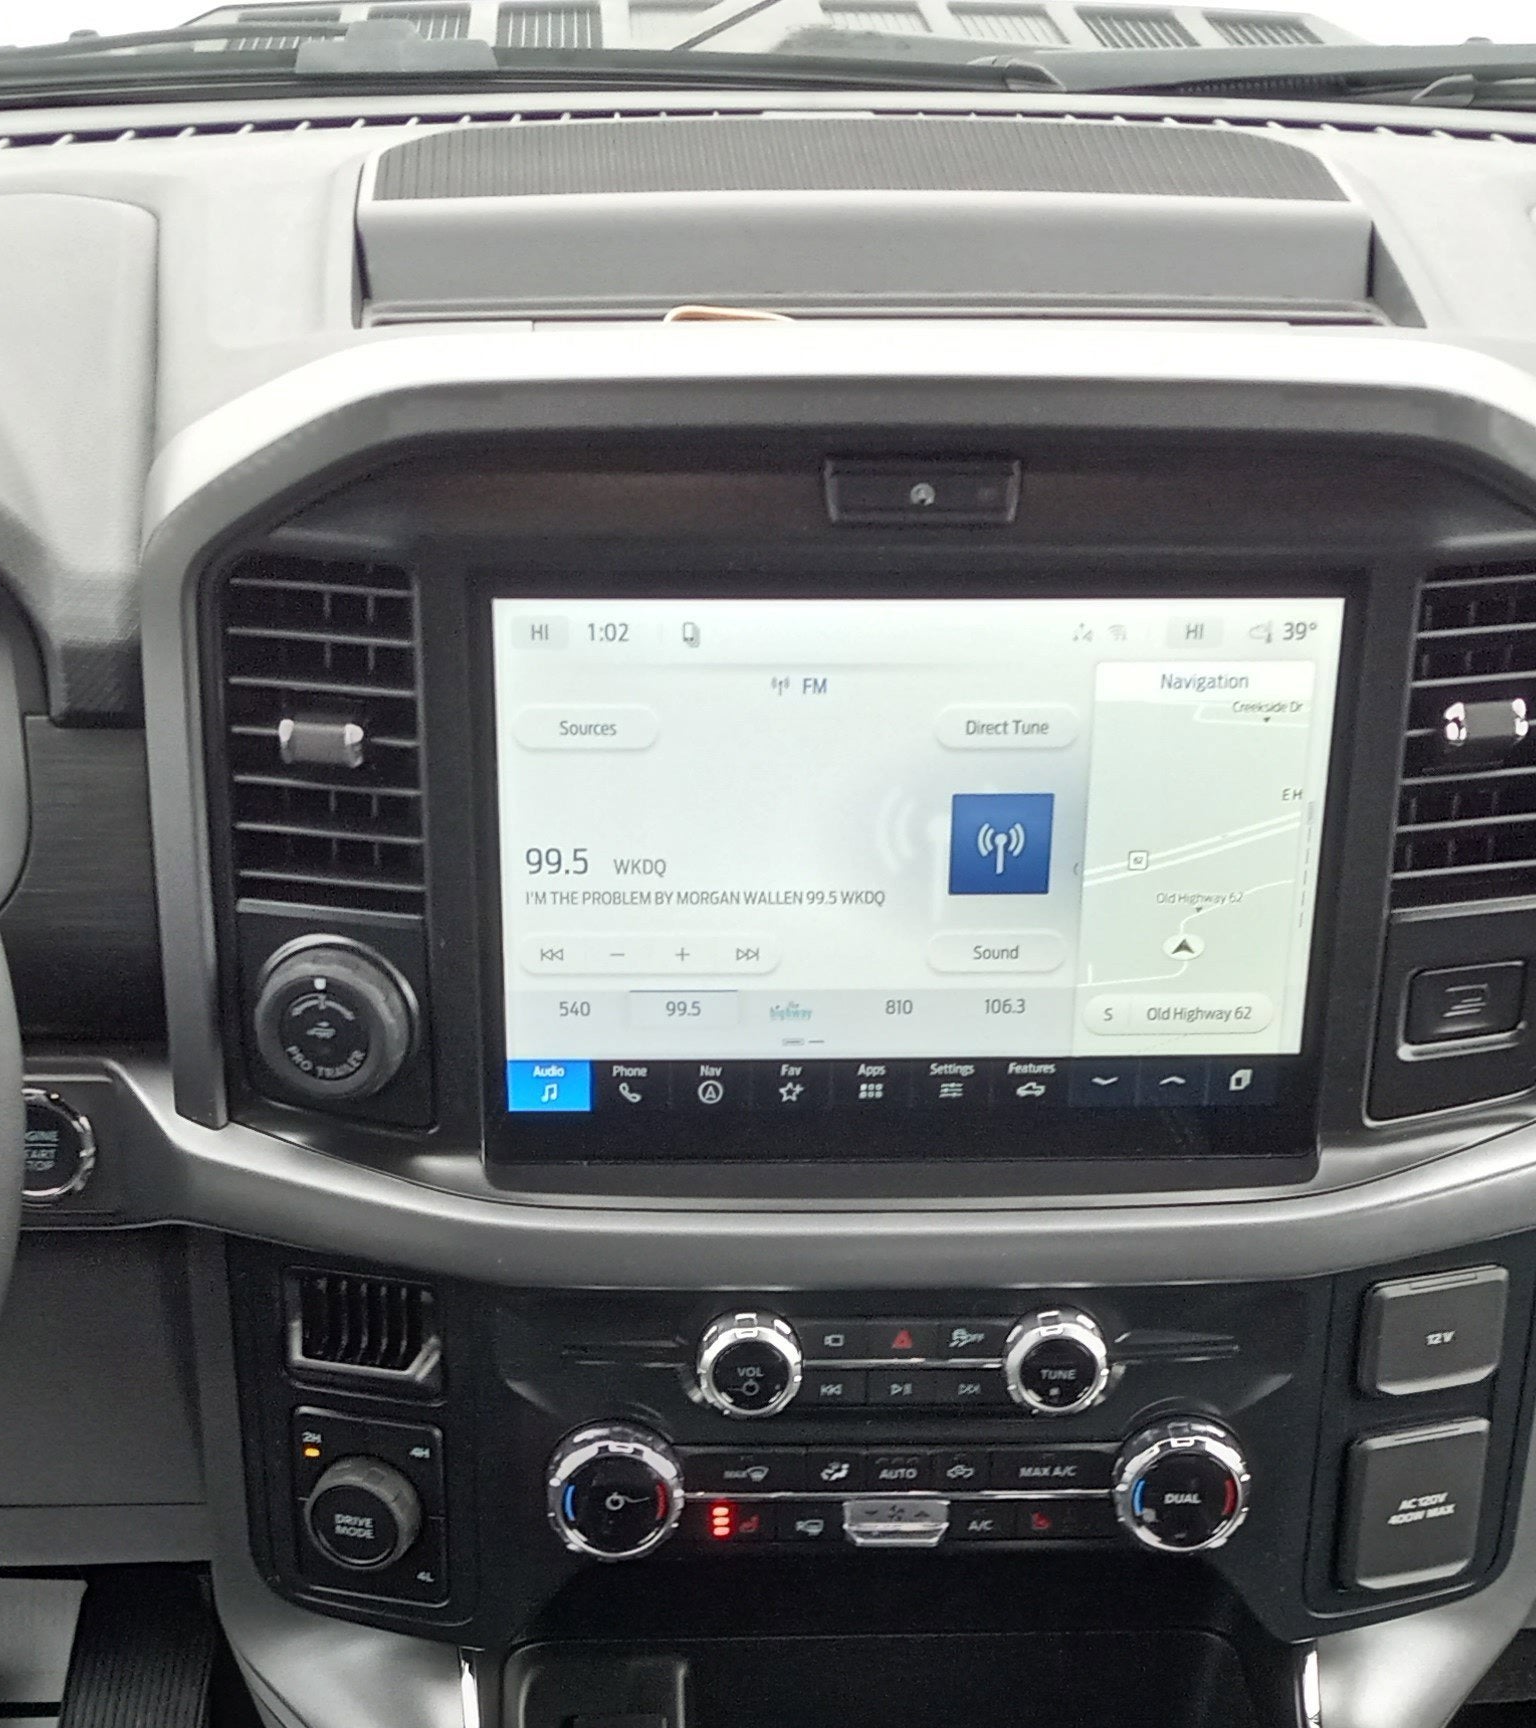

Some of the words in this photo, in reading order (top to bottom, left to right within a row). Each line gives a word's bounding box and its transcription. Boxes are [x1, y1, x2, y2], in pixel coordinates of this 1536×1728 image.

[530, 624, 550, 641] HI
[587, 622, 629, 641] 1:02
[1185, 624, 1204, 639] HI
[1281, 622, 1317, 640] 39°
[802, 678, 827, 694] FM
[1160, 674, 1249, 690] Navigation
[559, 720, 617, 736] Sources
[966, 719, 1008, 736] Direct
[1012, 719, 1049, 736] Tune
[525, 848, 589, 875] 99.5
[613, 858, 667, 876] WKDQ
[526, 891, 547, 906] I'M
[550, 891, 579, 906] THE
[582, 891, 655, 906] PROBLEM
[655, 891, 673, 906] BY
[677, 891, 741, 906] MORGAN
[743, 891, 804, 906] WALLEN
[807, 891, 837, 906] 99.5
[841, 891, 886, 907] WKDQ
[973, 945, 1019, 960] Sound
[558, 1002, 591, 1017] 540
[666, 1001, 701, 1017] 99.5
[885, 1000, 913, 1015] 810
[984, 999, 1026, 1015] 106.3
[1103, 1008, 1113, 1021] S
[1147, 1007, 1170, 1021] Old
[1173, 1007, 1231, 1023] Highway
[1234, 1006, 1252, 1020] 62
[533, 1064, 564, 1077] Audio
[613, 1065, 647, 1077] Phone
[700, 1065, 722, 1077] Nav
[780, 1064, 802, 1076] Fav
[858, 1063, 886, 1078] Apps
[930, 1063, 975, 1077] Settings
[1007, 1062, 1056, 1075] Features
[737, 1366, 764, 1378] VOL
[1040, 1369, 1076, 1381] TUNE
[302, 1431, 322, 1444] 2H
[878, 1468, 918, 1480] AUTO
[1019, 1466, 1051, 1478] MAX
[1052, 1465, 1077, 1478] A/C
[1165, 1493, 1202, 1505] DUAL
[1426, 1503, 1457, 1519] MAX
[334, 1513, 374, 1529] DRIVE
[968, 1520, 994, 1532] A/C
[334, 1525, 375, 1540] MODE
[416, 1571, 435, 1583] 4L
